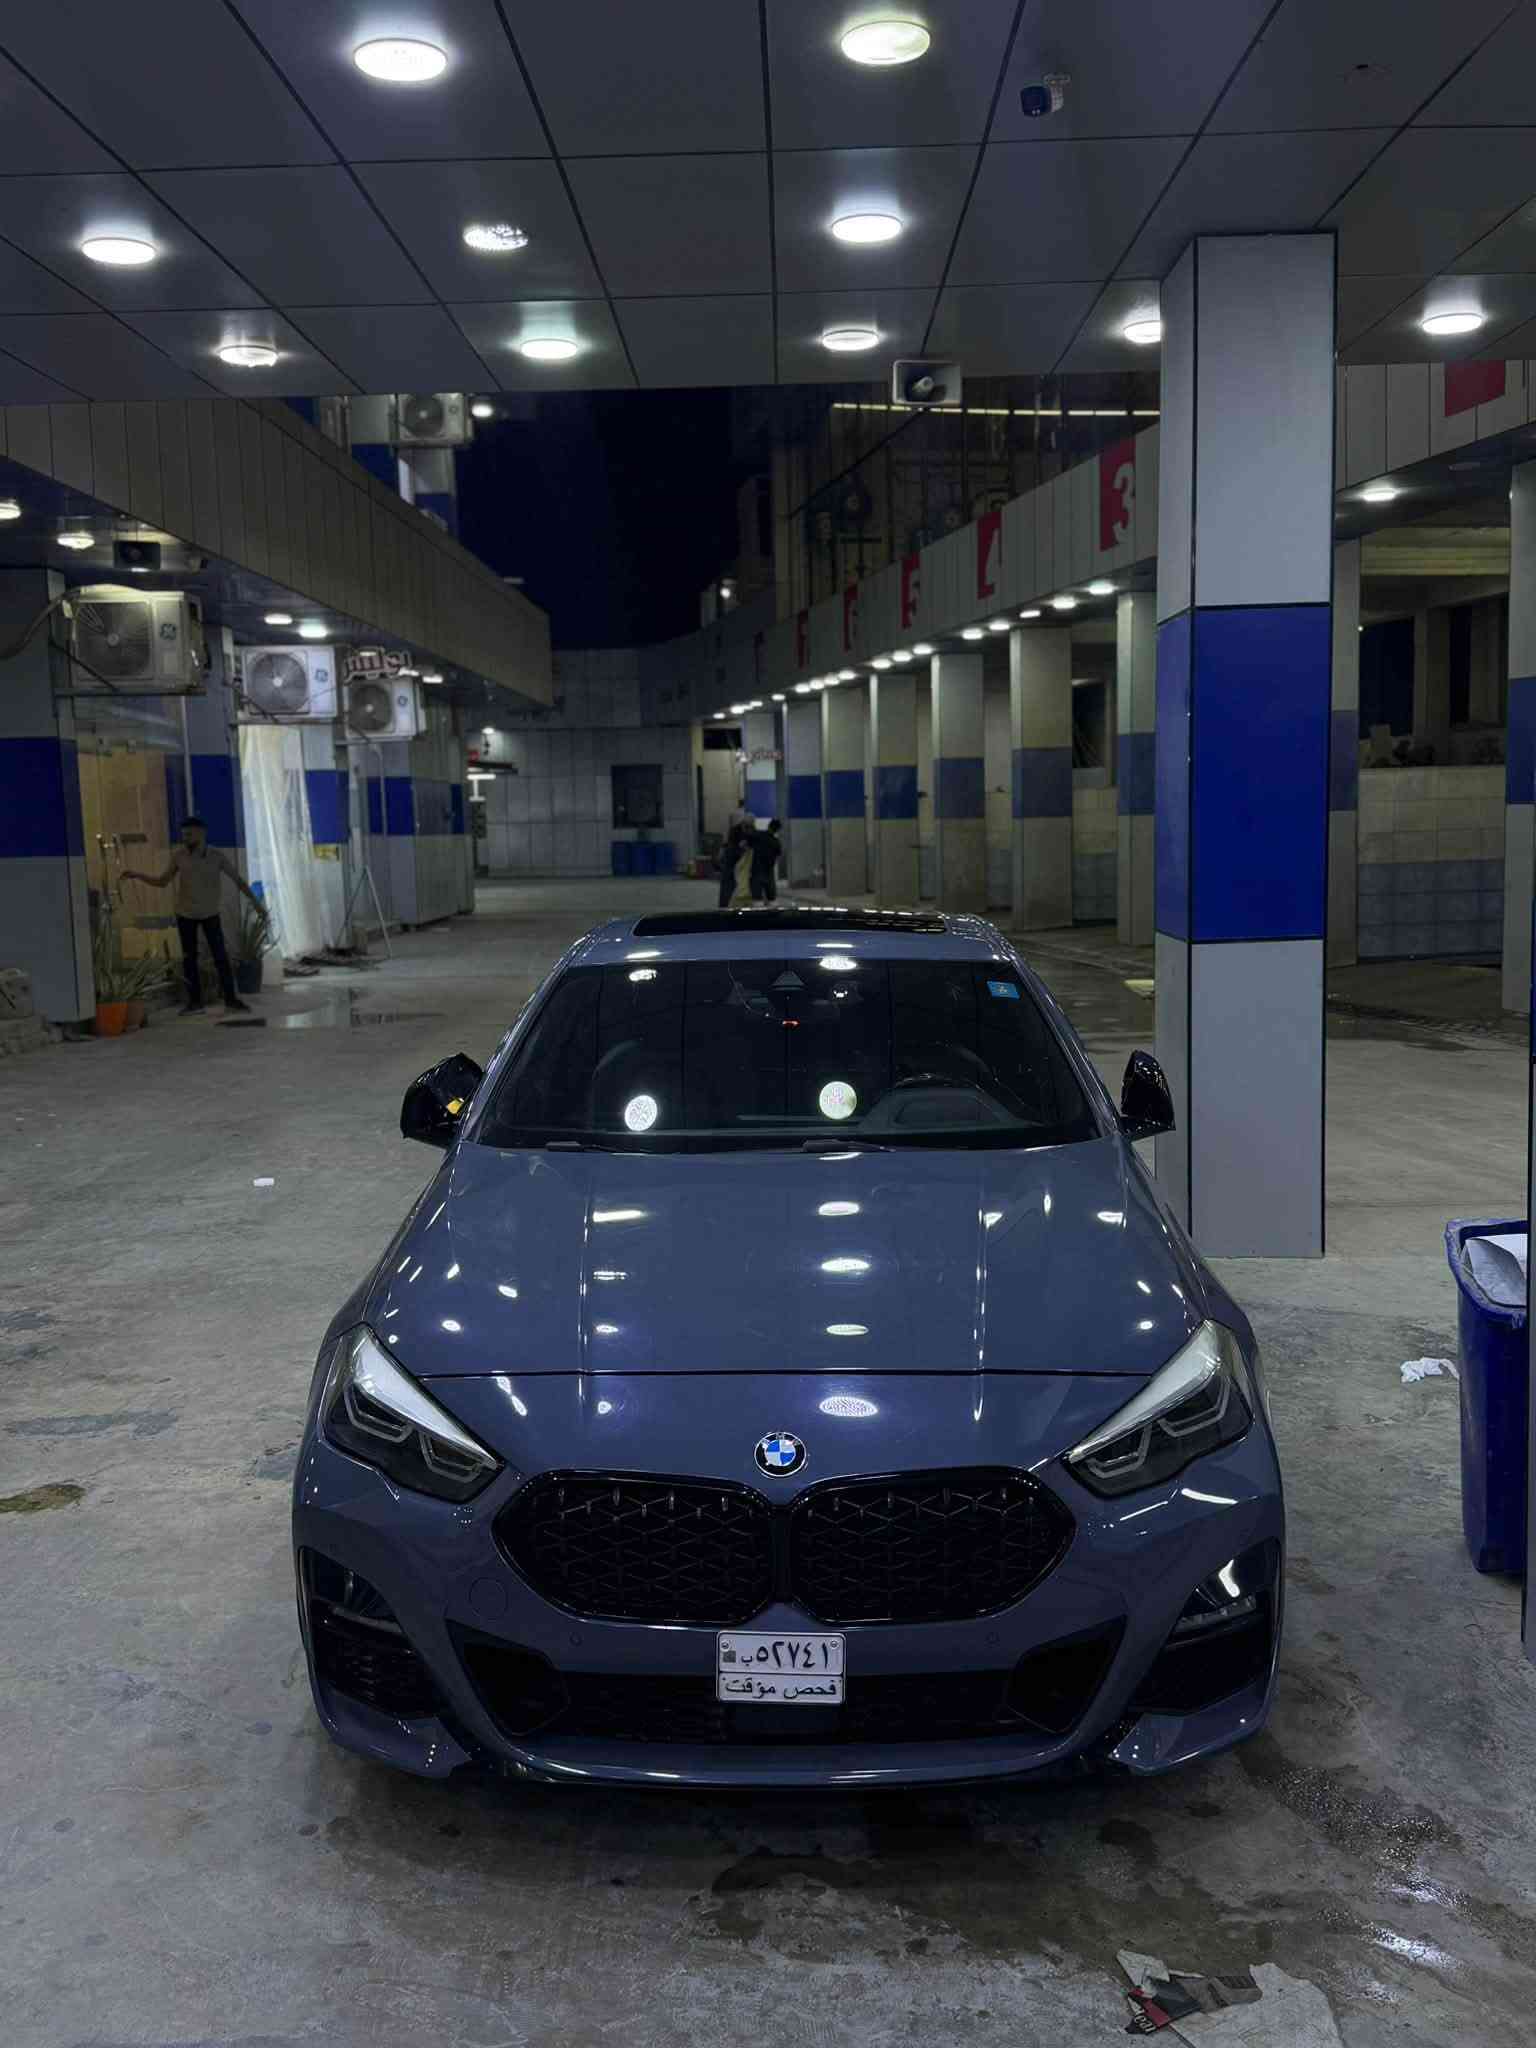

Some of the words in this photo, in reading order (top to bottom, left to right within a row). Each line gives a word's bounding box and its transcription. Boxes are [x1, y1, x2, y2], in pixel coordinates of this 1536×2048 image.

[1112, 461, 1136, 545] 3
[756, 1641, 829, 1669] ٥٢٧٤١
[725, 1678, 776, 1699] مؤقت
[783, 1679, 837, 1700] فحص
